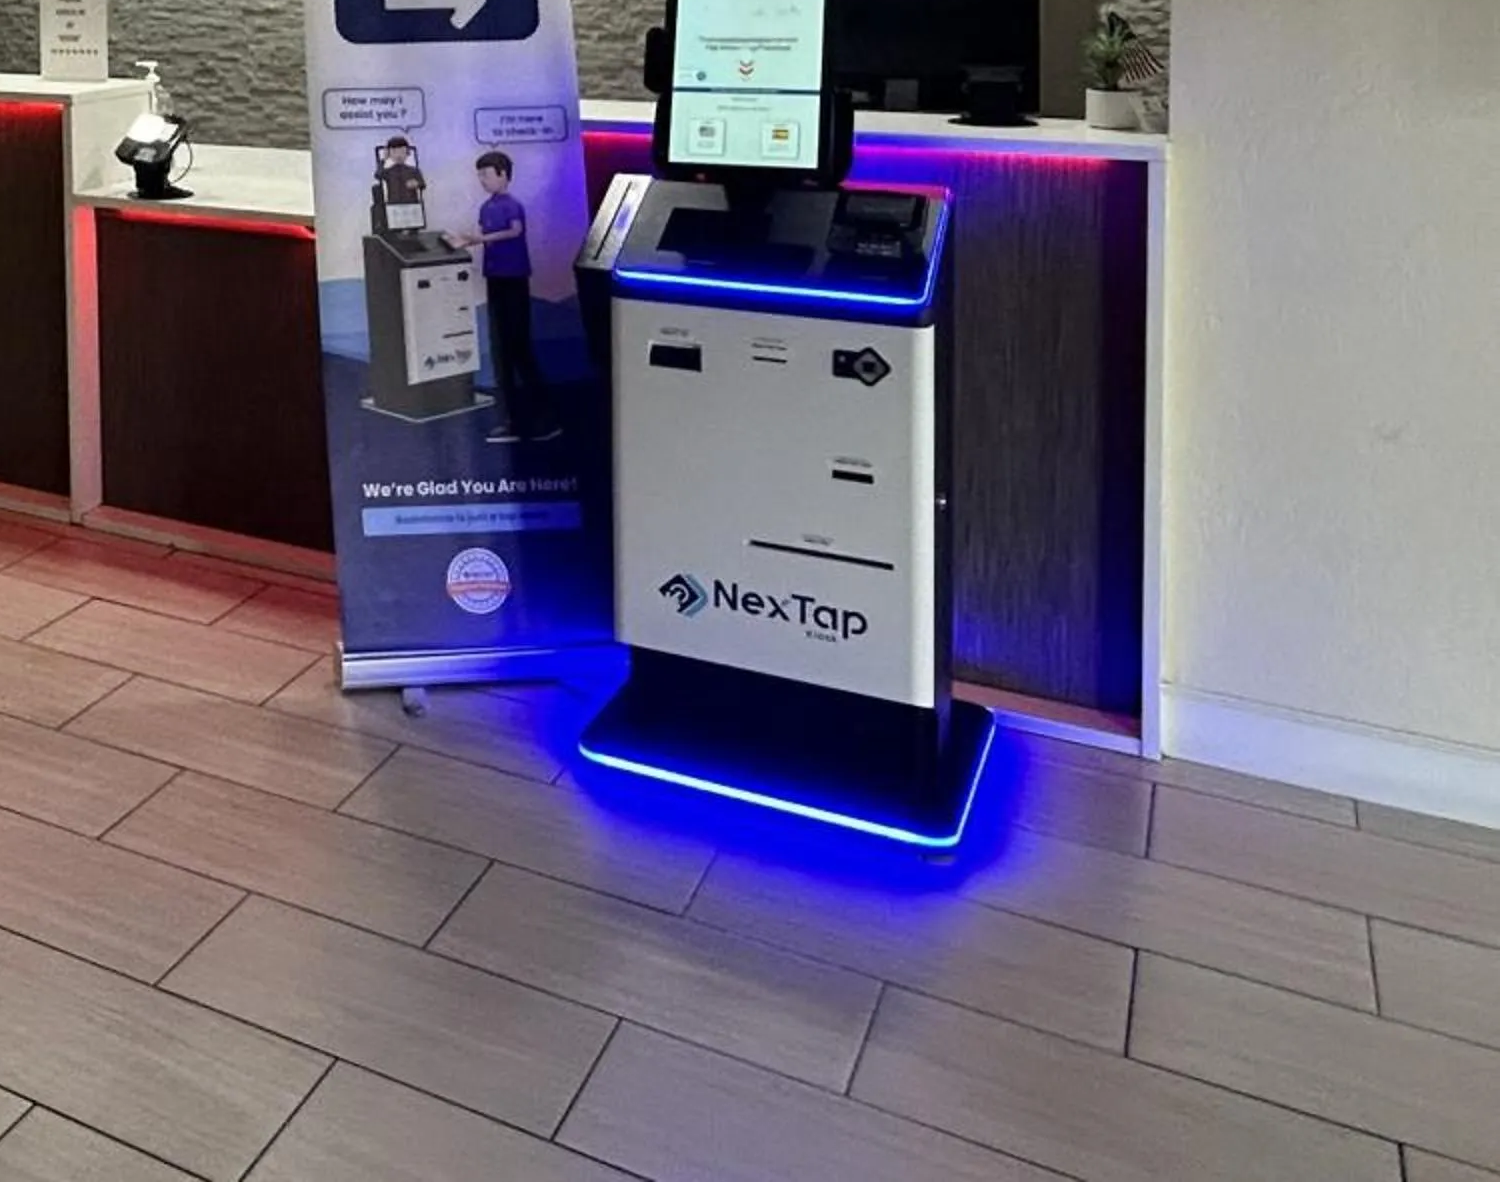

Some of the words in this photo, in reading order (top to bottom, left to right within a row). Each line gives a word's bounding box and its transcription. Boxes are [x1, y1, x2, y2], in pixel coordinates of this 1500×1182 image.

[342, 96, 367, 105] How
[369, 97, 396, 108] may
[340, 110, 373, 120] assist
[376, 111, 398, 122] you
[362, 481, 414, 498] We're
[417, 479, 459, 496] Glad
[461, 479, 495, 495] You
[497, 478, 527, 493] Are
[713, 579, 868, 640] NexTap
